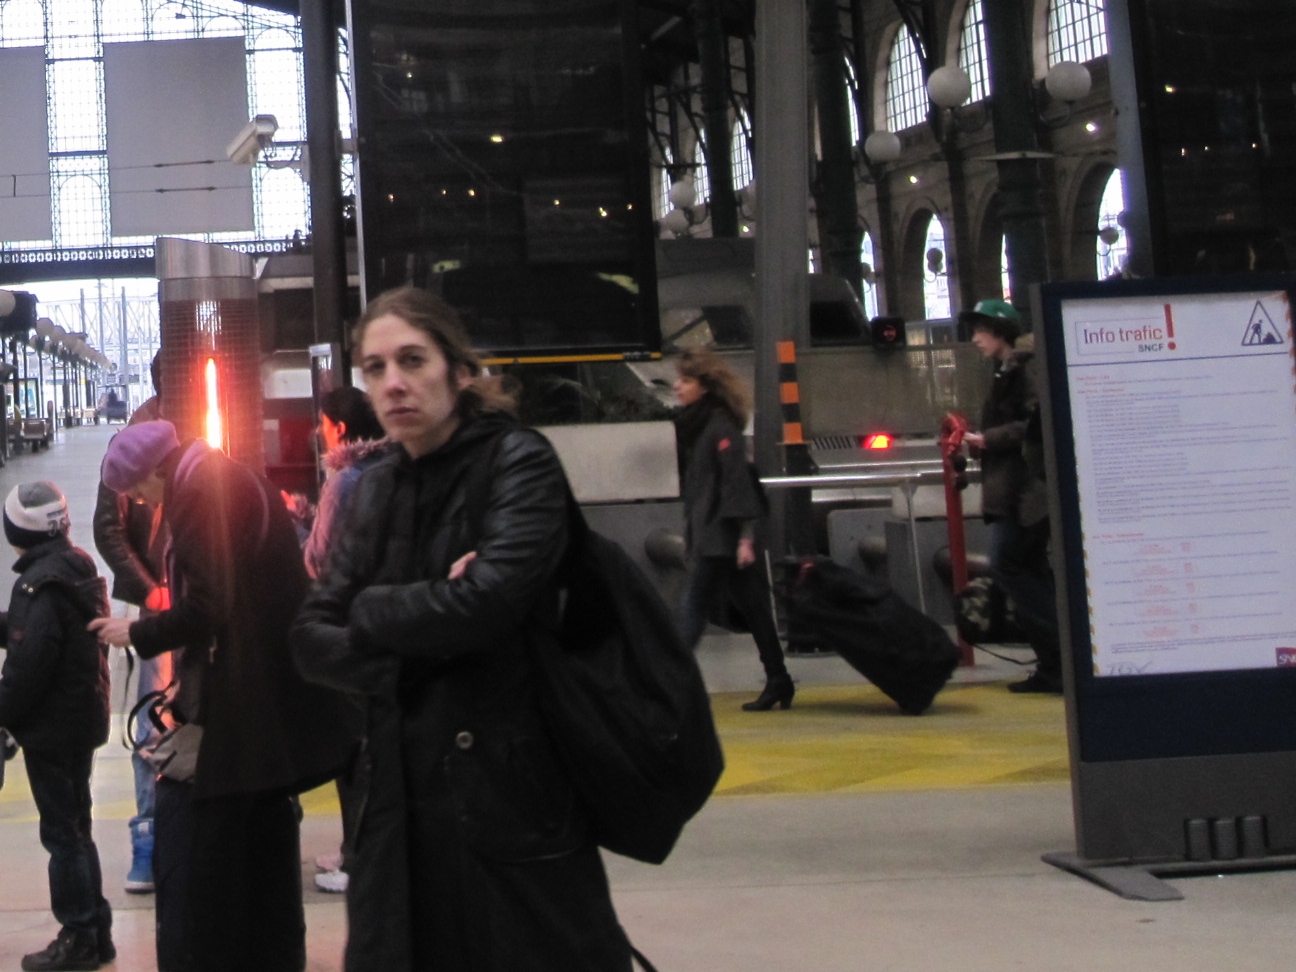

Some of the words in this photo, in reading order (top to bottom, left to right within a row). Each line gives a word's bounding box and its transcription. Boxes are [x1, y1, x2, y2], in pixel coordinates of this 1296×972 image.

[1084, 327, 1115, 345] Info
[1119, 325, 1163, 342] trafic
[1138, 342, 1165, 353] SNCF
